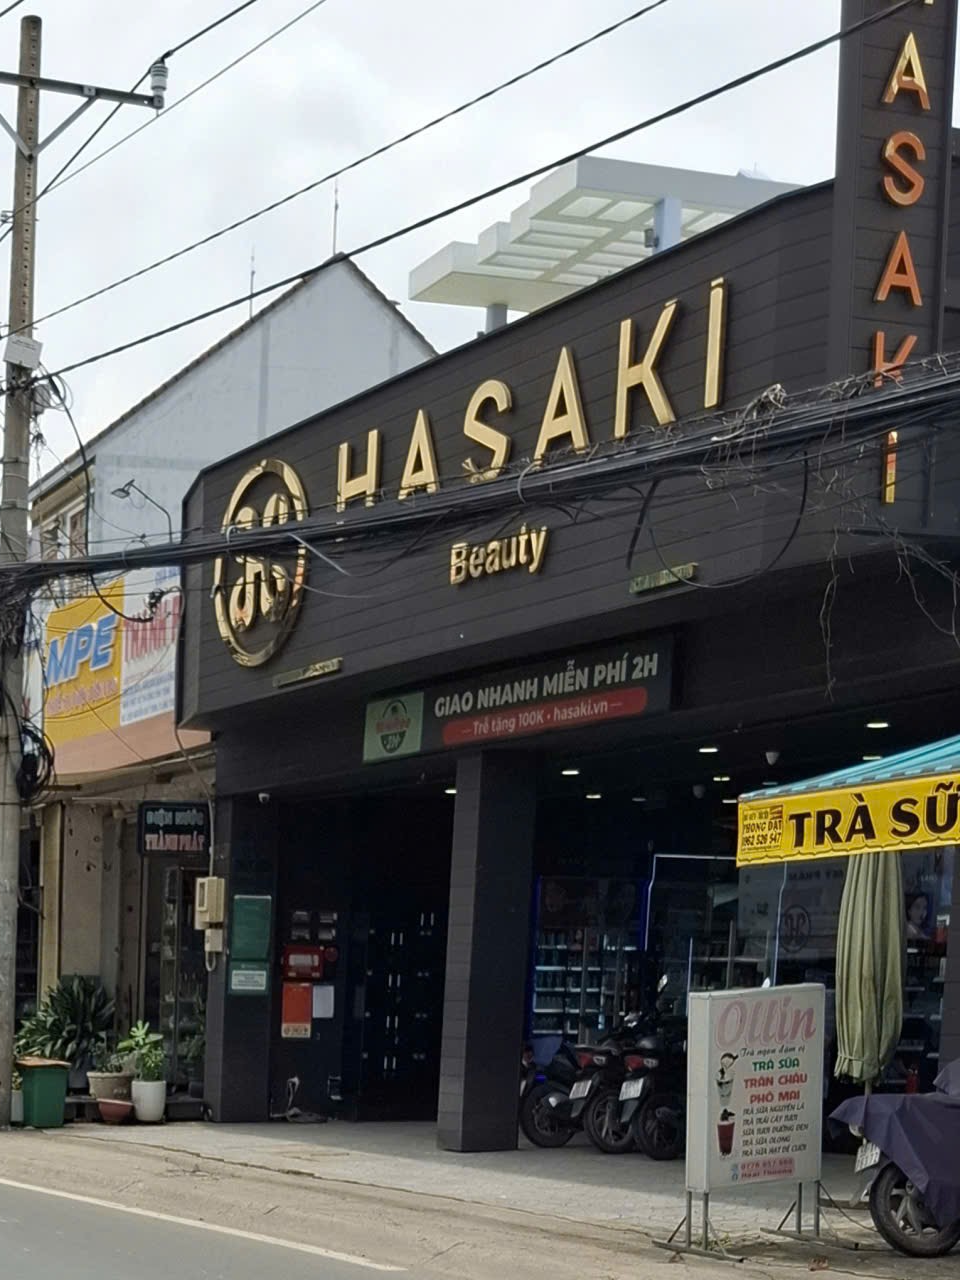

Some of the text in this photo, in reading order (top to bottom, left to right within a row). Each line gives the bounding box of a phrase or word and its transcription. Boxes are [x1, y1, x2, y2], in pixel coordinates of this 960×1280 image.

[873, 0, 933, 503] ASAKI
[338, 277, 728, 512] HASAKI
[450, 523, 547, 585] Beauty
[47, 612, 118, 688] MPE
[434, 652, 658, 718] GIAO NHANH MIỄN PHÍ 2H
[519, 710, 544, 727] 100K
[553, 699, 608, 722] hasaki.vn
[788, 793, 876, 848] TRÀ
[778, 1071, 808, 1085] CHÂU
[778, 1090, 800, 1101] MAI
